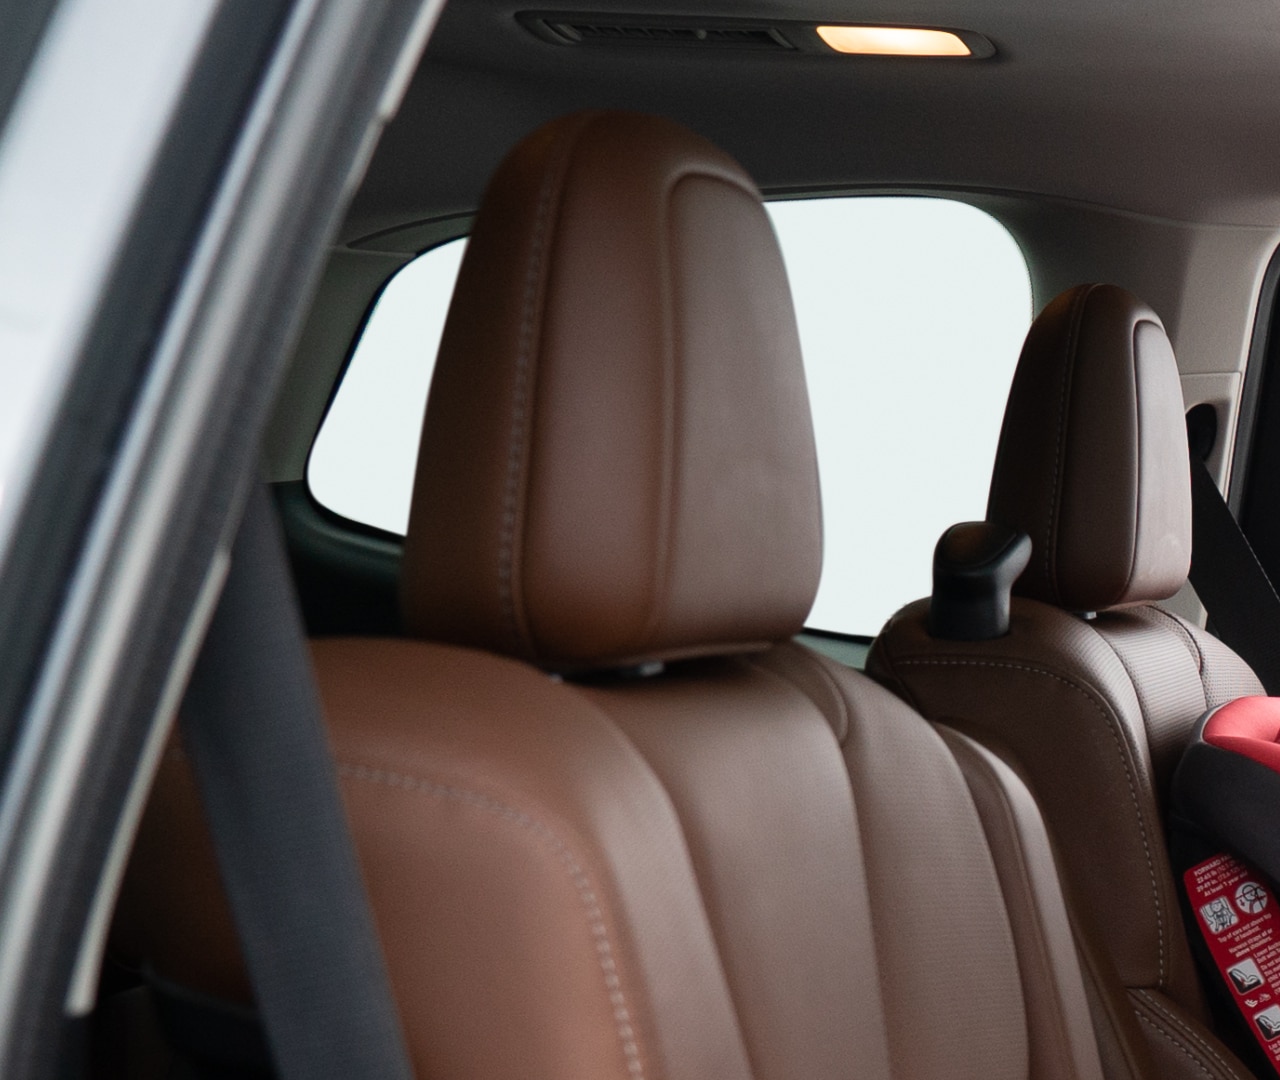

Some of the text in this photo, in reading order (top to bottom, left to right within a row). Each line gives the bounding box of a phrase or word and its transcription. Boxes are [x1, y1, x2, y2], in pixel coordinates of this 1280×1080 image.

[1193, 859, 1221, 876] FORWARD
[1227, 875, 1239, 885] year
[1250, 917, 1264, 927] above
